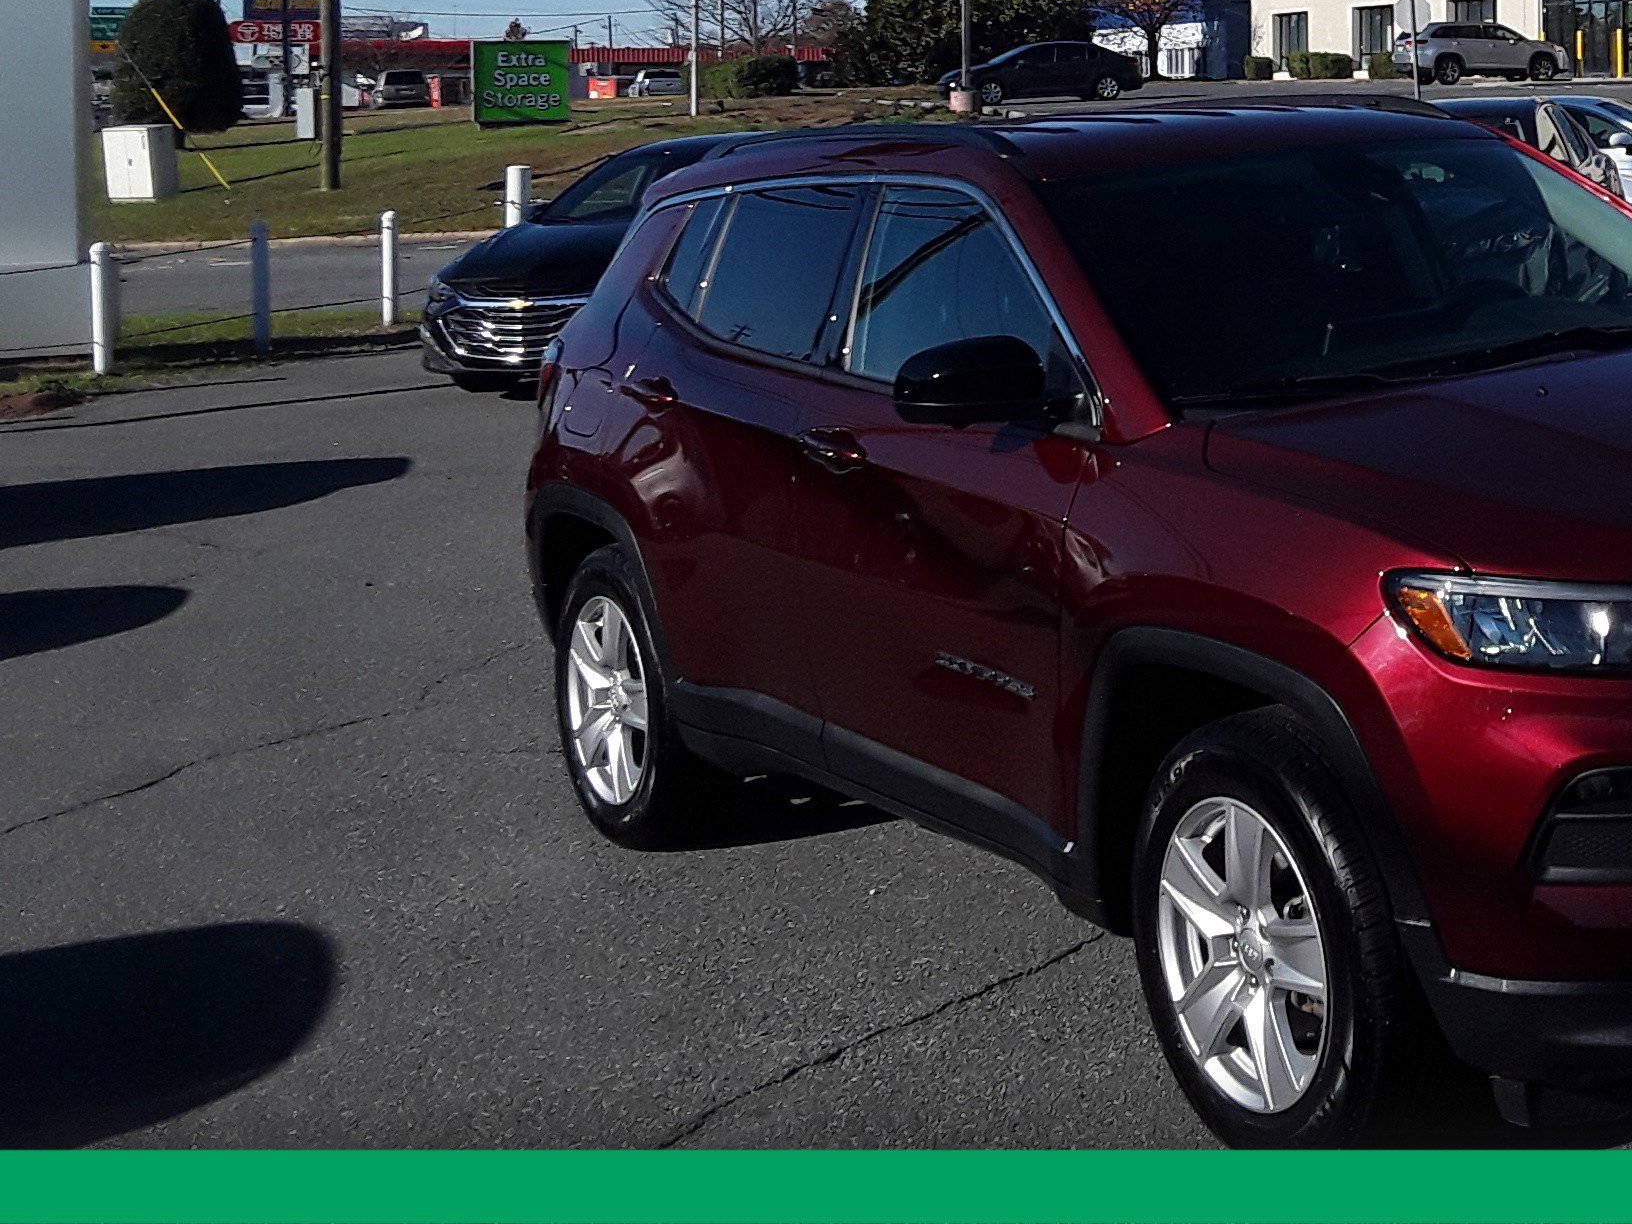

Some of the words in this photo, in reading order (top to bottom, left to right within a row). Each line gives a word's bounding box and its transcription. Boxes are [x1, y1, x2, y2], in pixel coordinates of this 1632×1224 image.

[496, 51, 546, 67] Extra
[493, 70, 551, 90] Space
[482, 91, 562, 110] Storage
